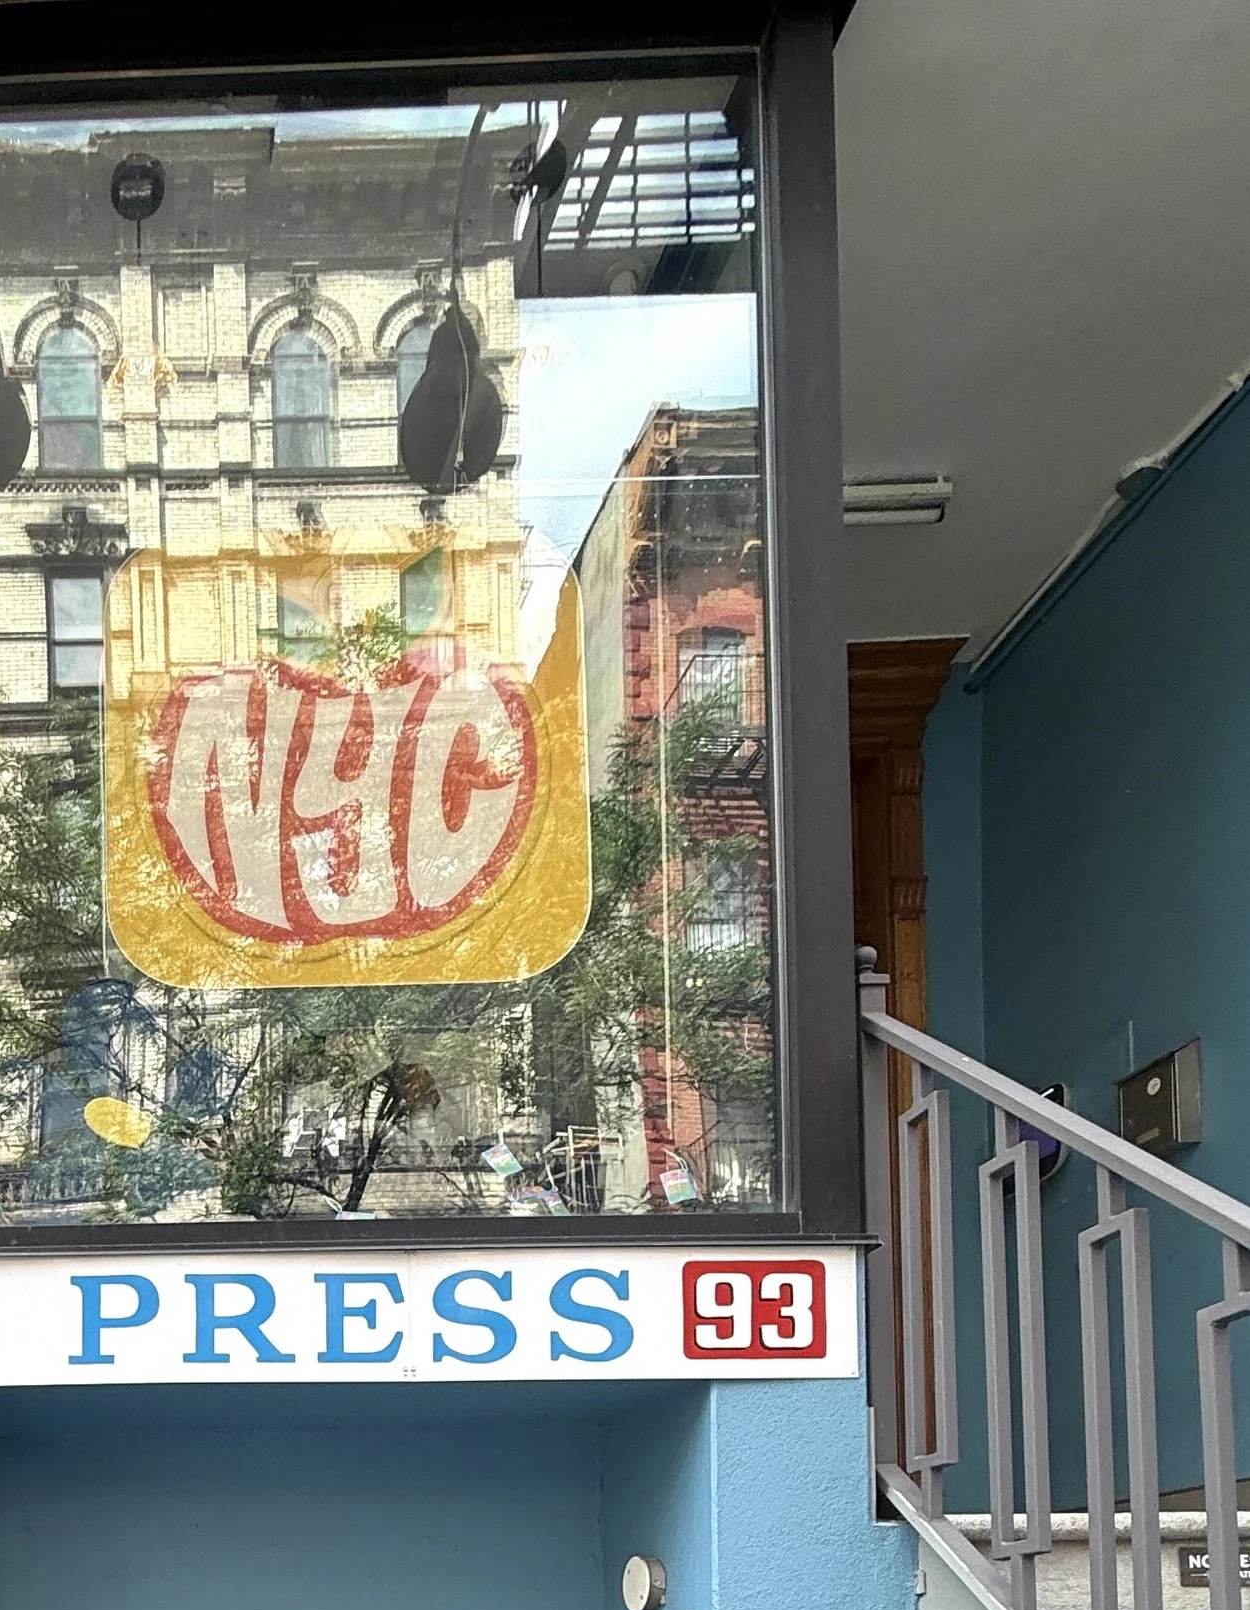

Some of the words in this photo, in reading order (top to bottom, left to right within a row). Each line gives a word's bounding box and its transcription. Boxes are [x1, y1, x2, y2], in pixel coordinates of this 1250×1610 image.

[164, 670, 526, 931] NYC
[67, 1268, 635, 1366] PRESS
[694, 1272, 815, 1352] 93
